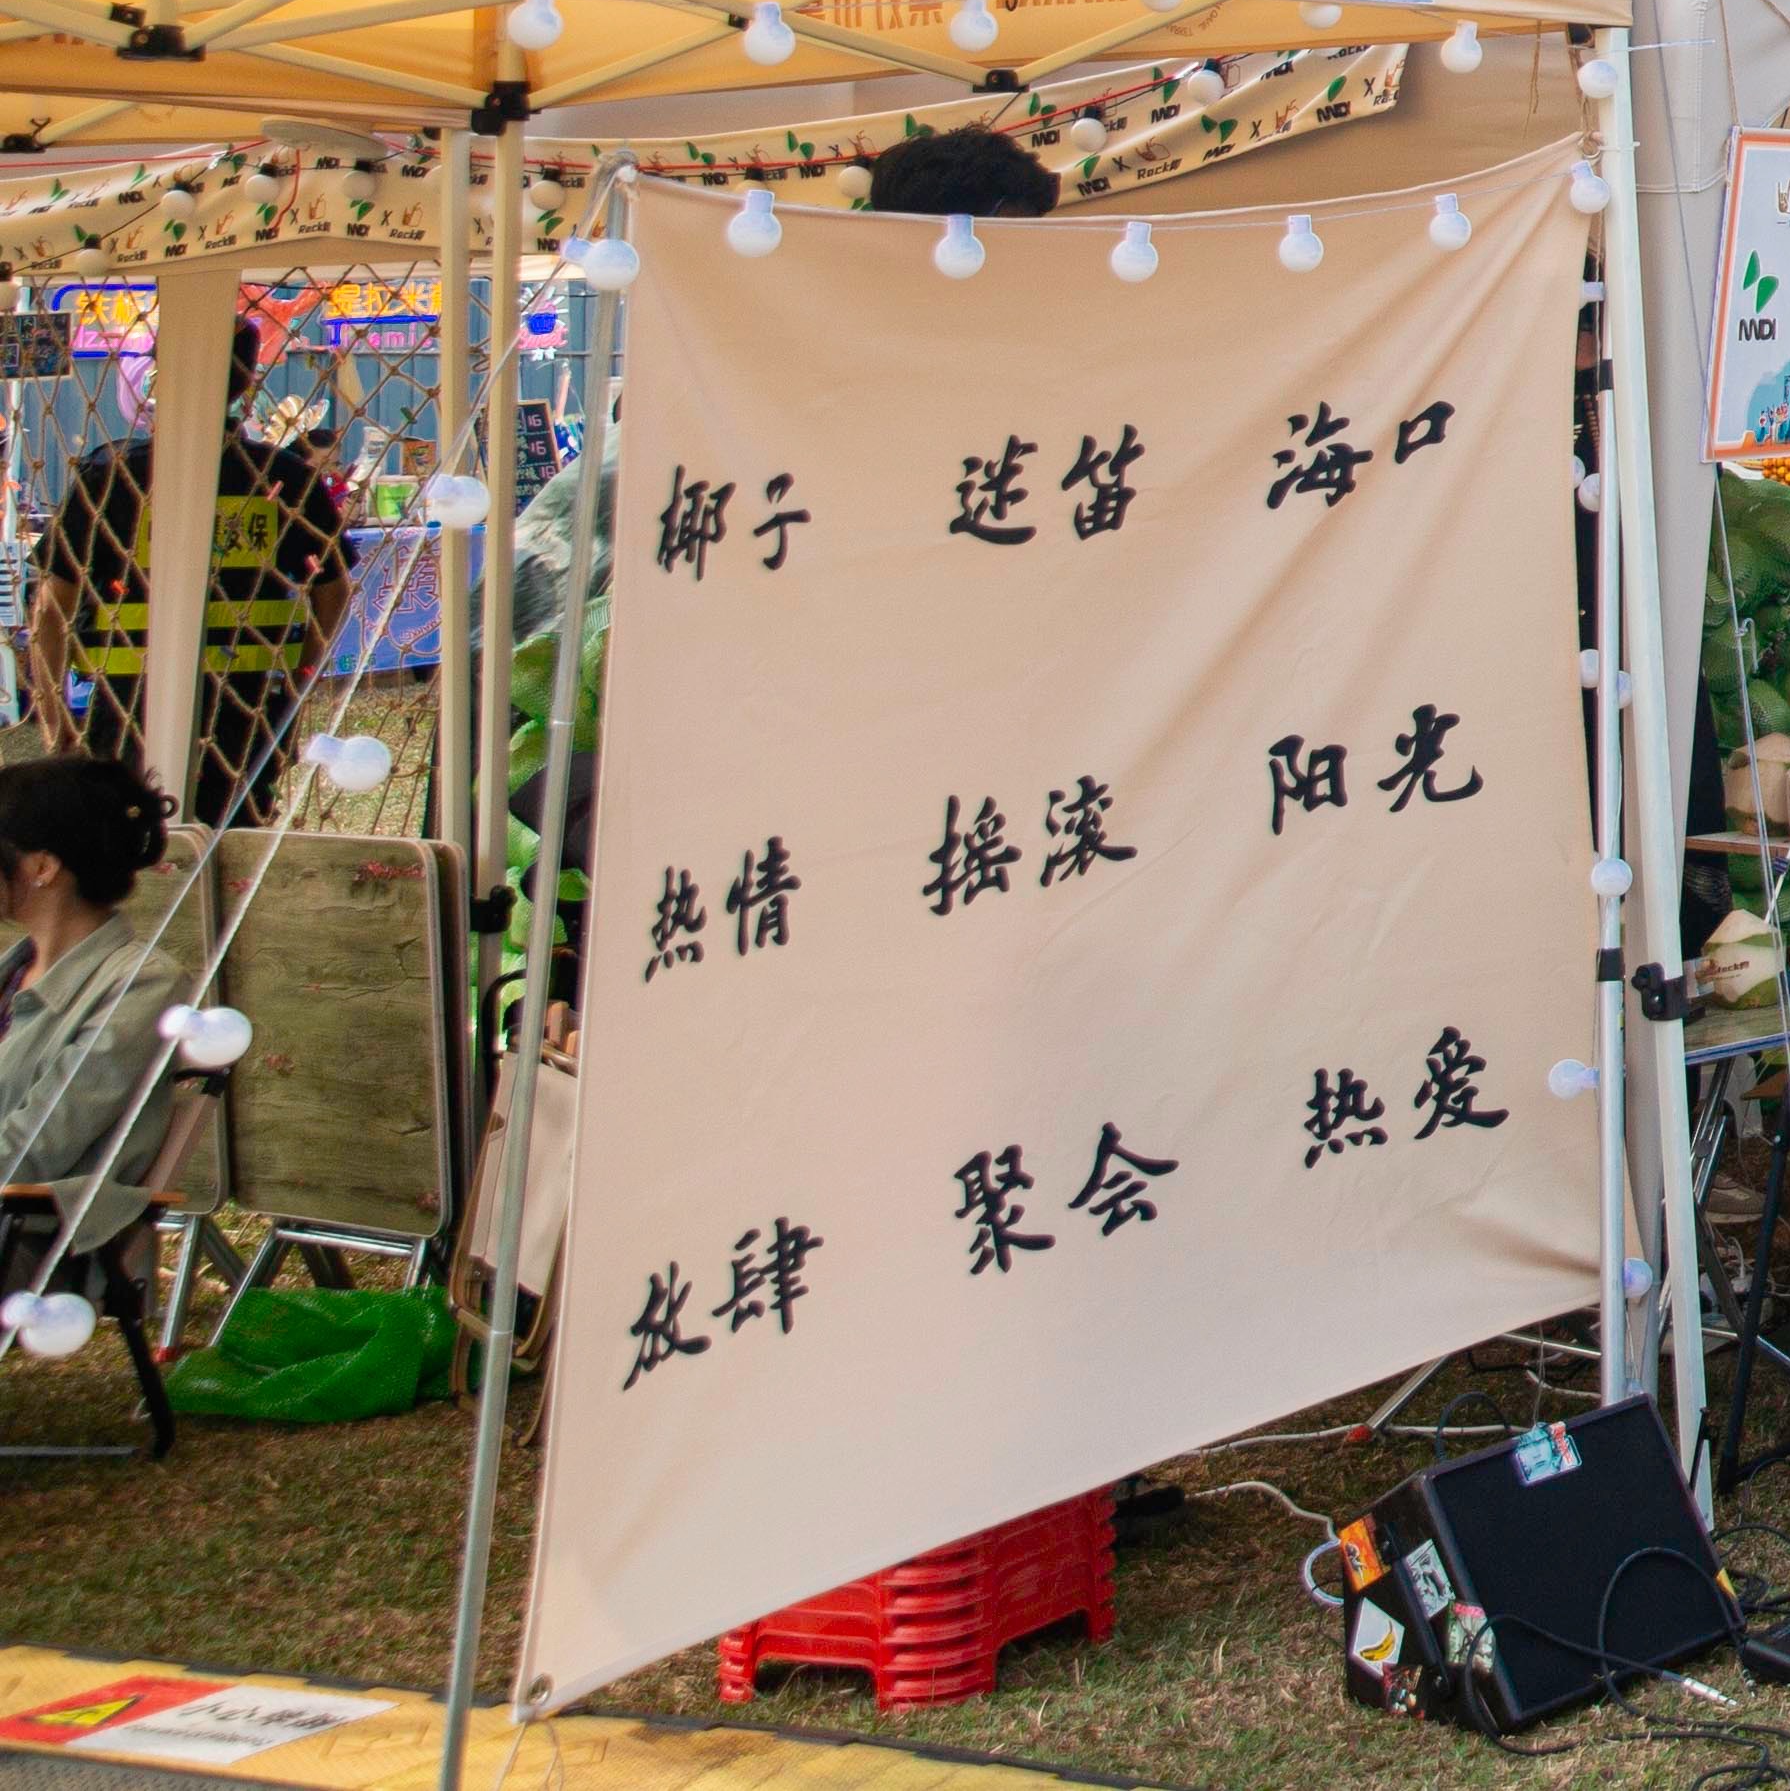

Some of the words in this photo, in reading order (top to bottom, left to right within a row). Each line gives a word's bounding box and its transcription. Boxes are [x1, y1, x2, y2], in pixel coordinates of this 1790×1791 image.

[75, 289, 160, 326] 铁板
[658, 464, 812, 582] 椰子
[948, 425, 1146, 547] 迷笛
[1267, 401, 1456, 511] 海口
[645, 835, 801, 982] 热情
[923, 775, 1138, 916] 摇滚
[1269, 704, 1484, 835] 阳光
[623, 1218, 824, 1392] 放肆
[954, 1123, 1179, 1275] 聚会
[1303, 1026, 1509, 1169] 热爱
